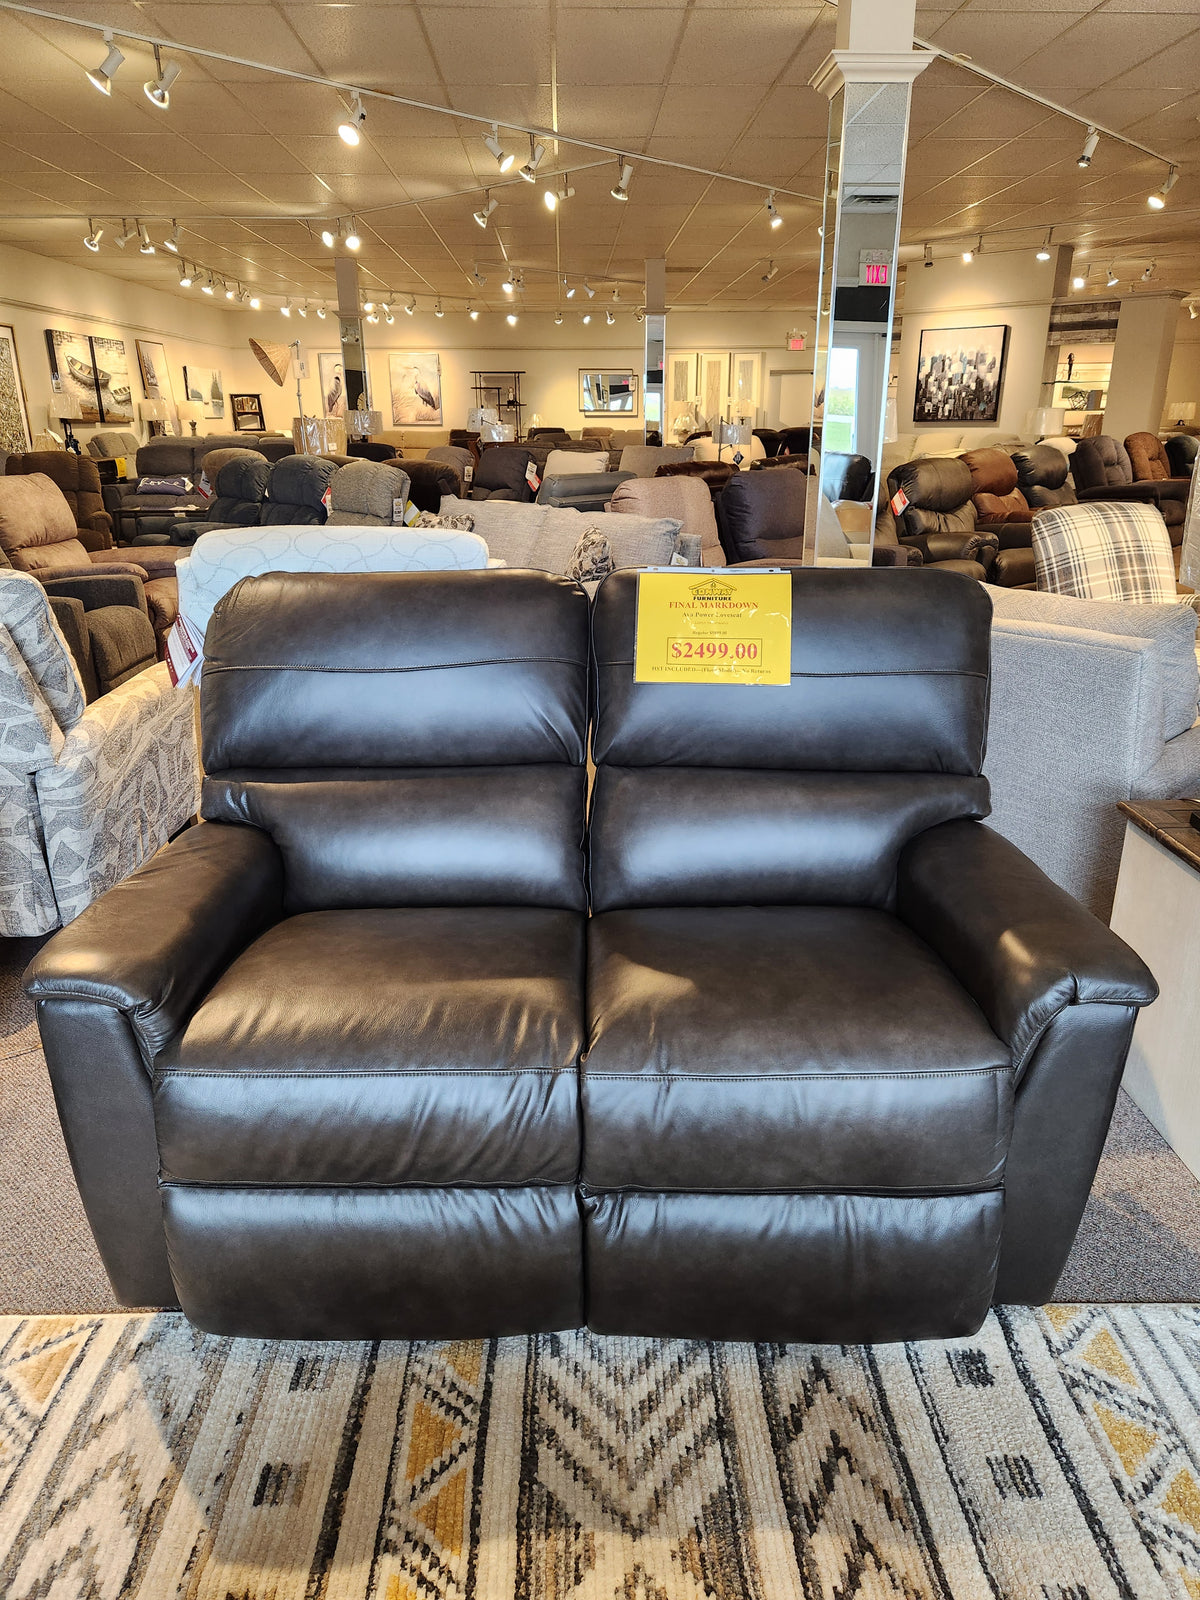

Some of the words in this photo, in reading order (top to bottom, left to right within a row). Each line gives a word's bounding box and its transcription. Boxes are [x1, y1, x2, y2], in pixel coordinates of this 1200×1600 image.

[692, 588, 734, 596] CONWAY
[669, 601, 698, 609] FINAL
[699, 601, 759, 609] MARKDOWN
[671, 642, 758, 659] $2499.00
